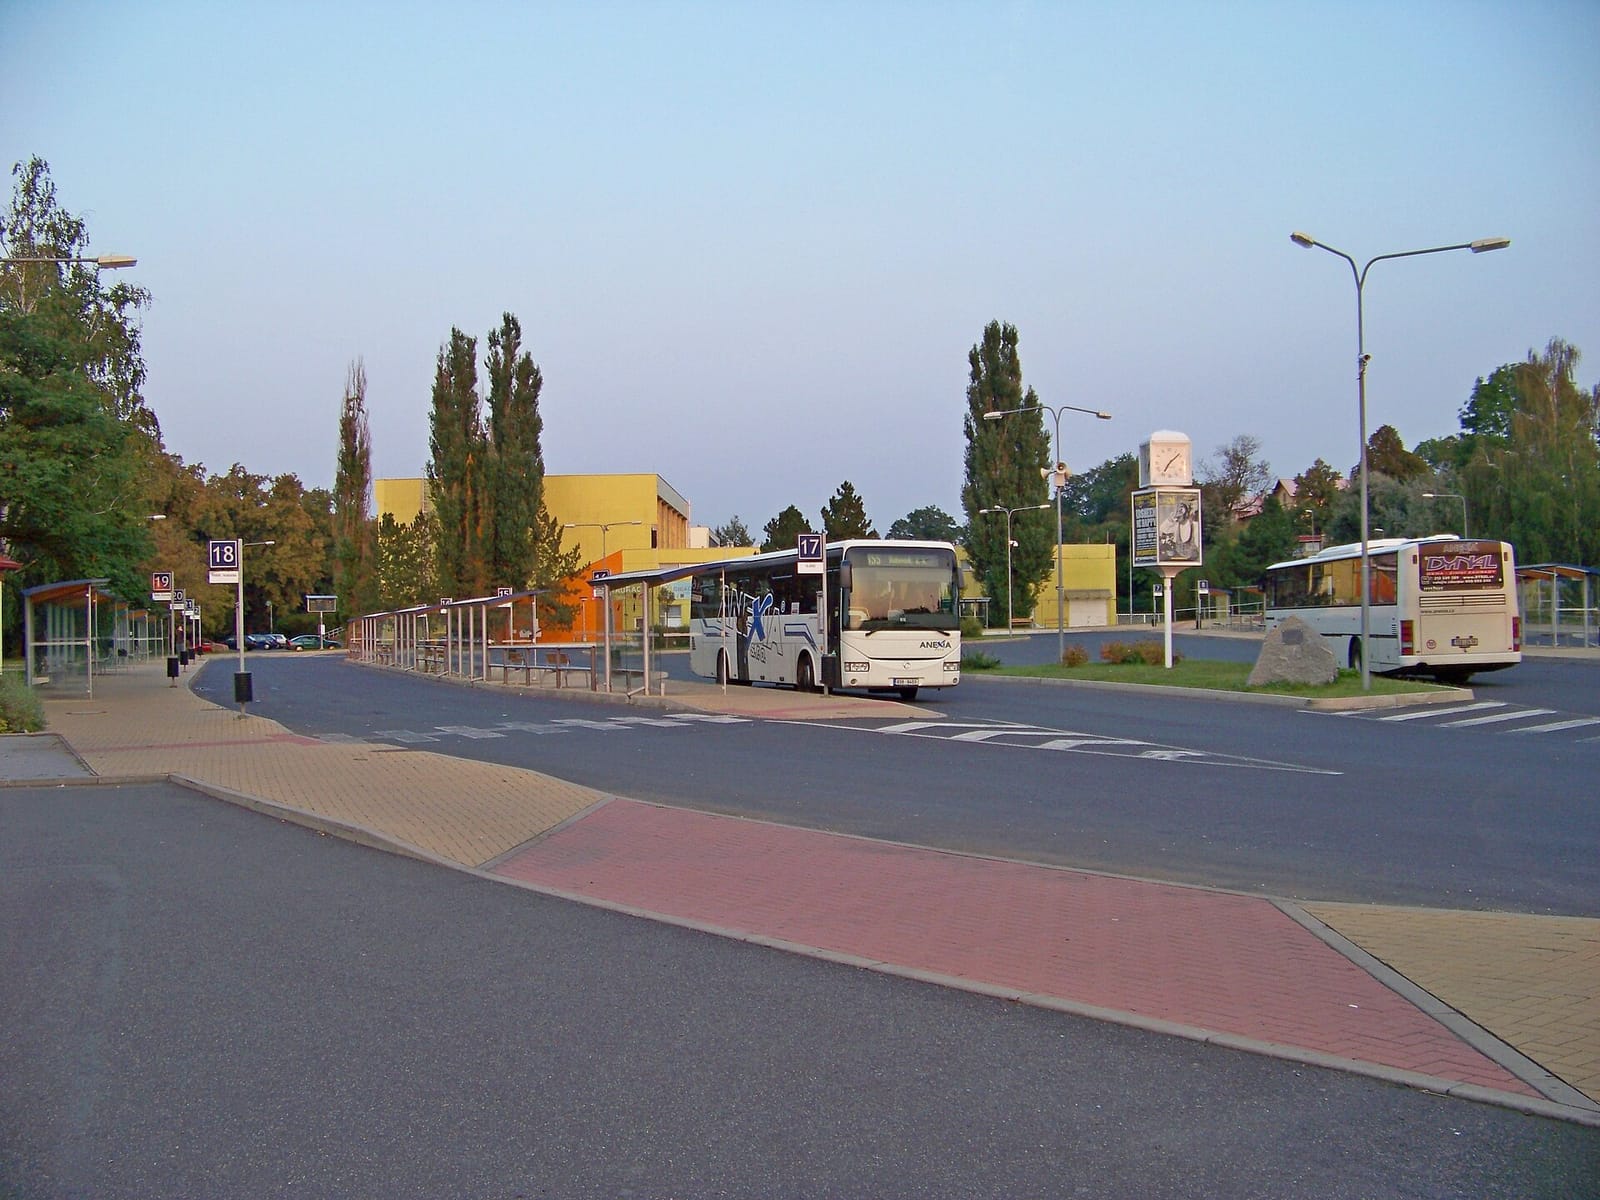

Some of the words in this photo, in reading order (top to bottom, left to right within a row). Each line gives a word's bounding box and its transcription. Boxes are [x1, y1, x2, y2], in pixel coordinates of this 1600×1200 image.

[800, 539, 820, 555] 17
[213, 546, 234, 562] 18
[155, 576, 169, 587] 19
[920, 640, 952, 649] ANEXIA
